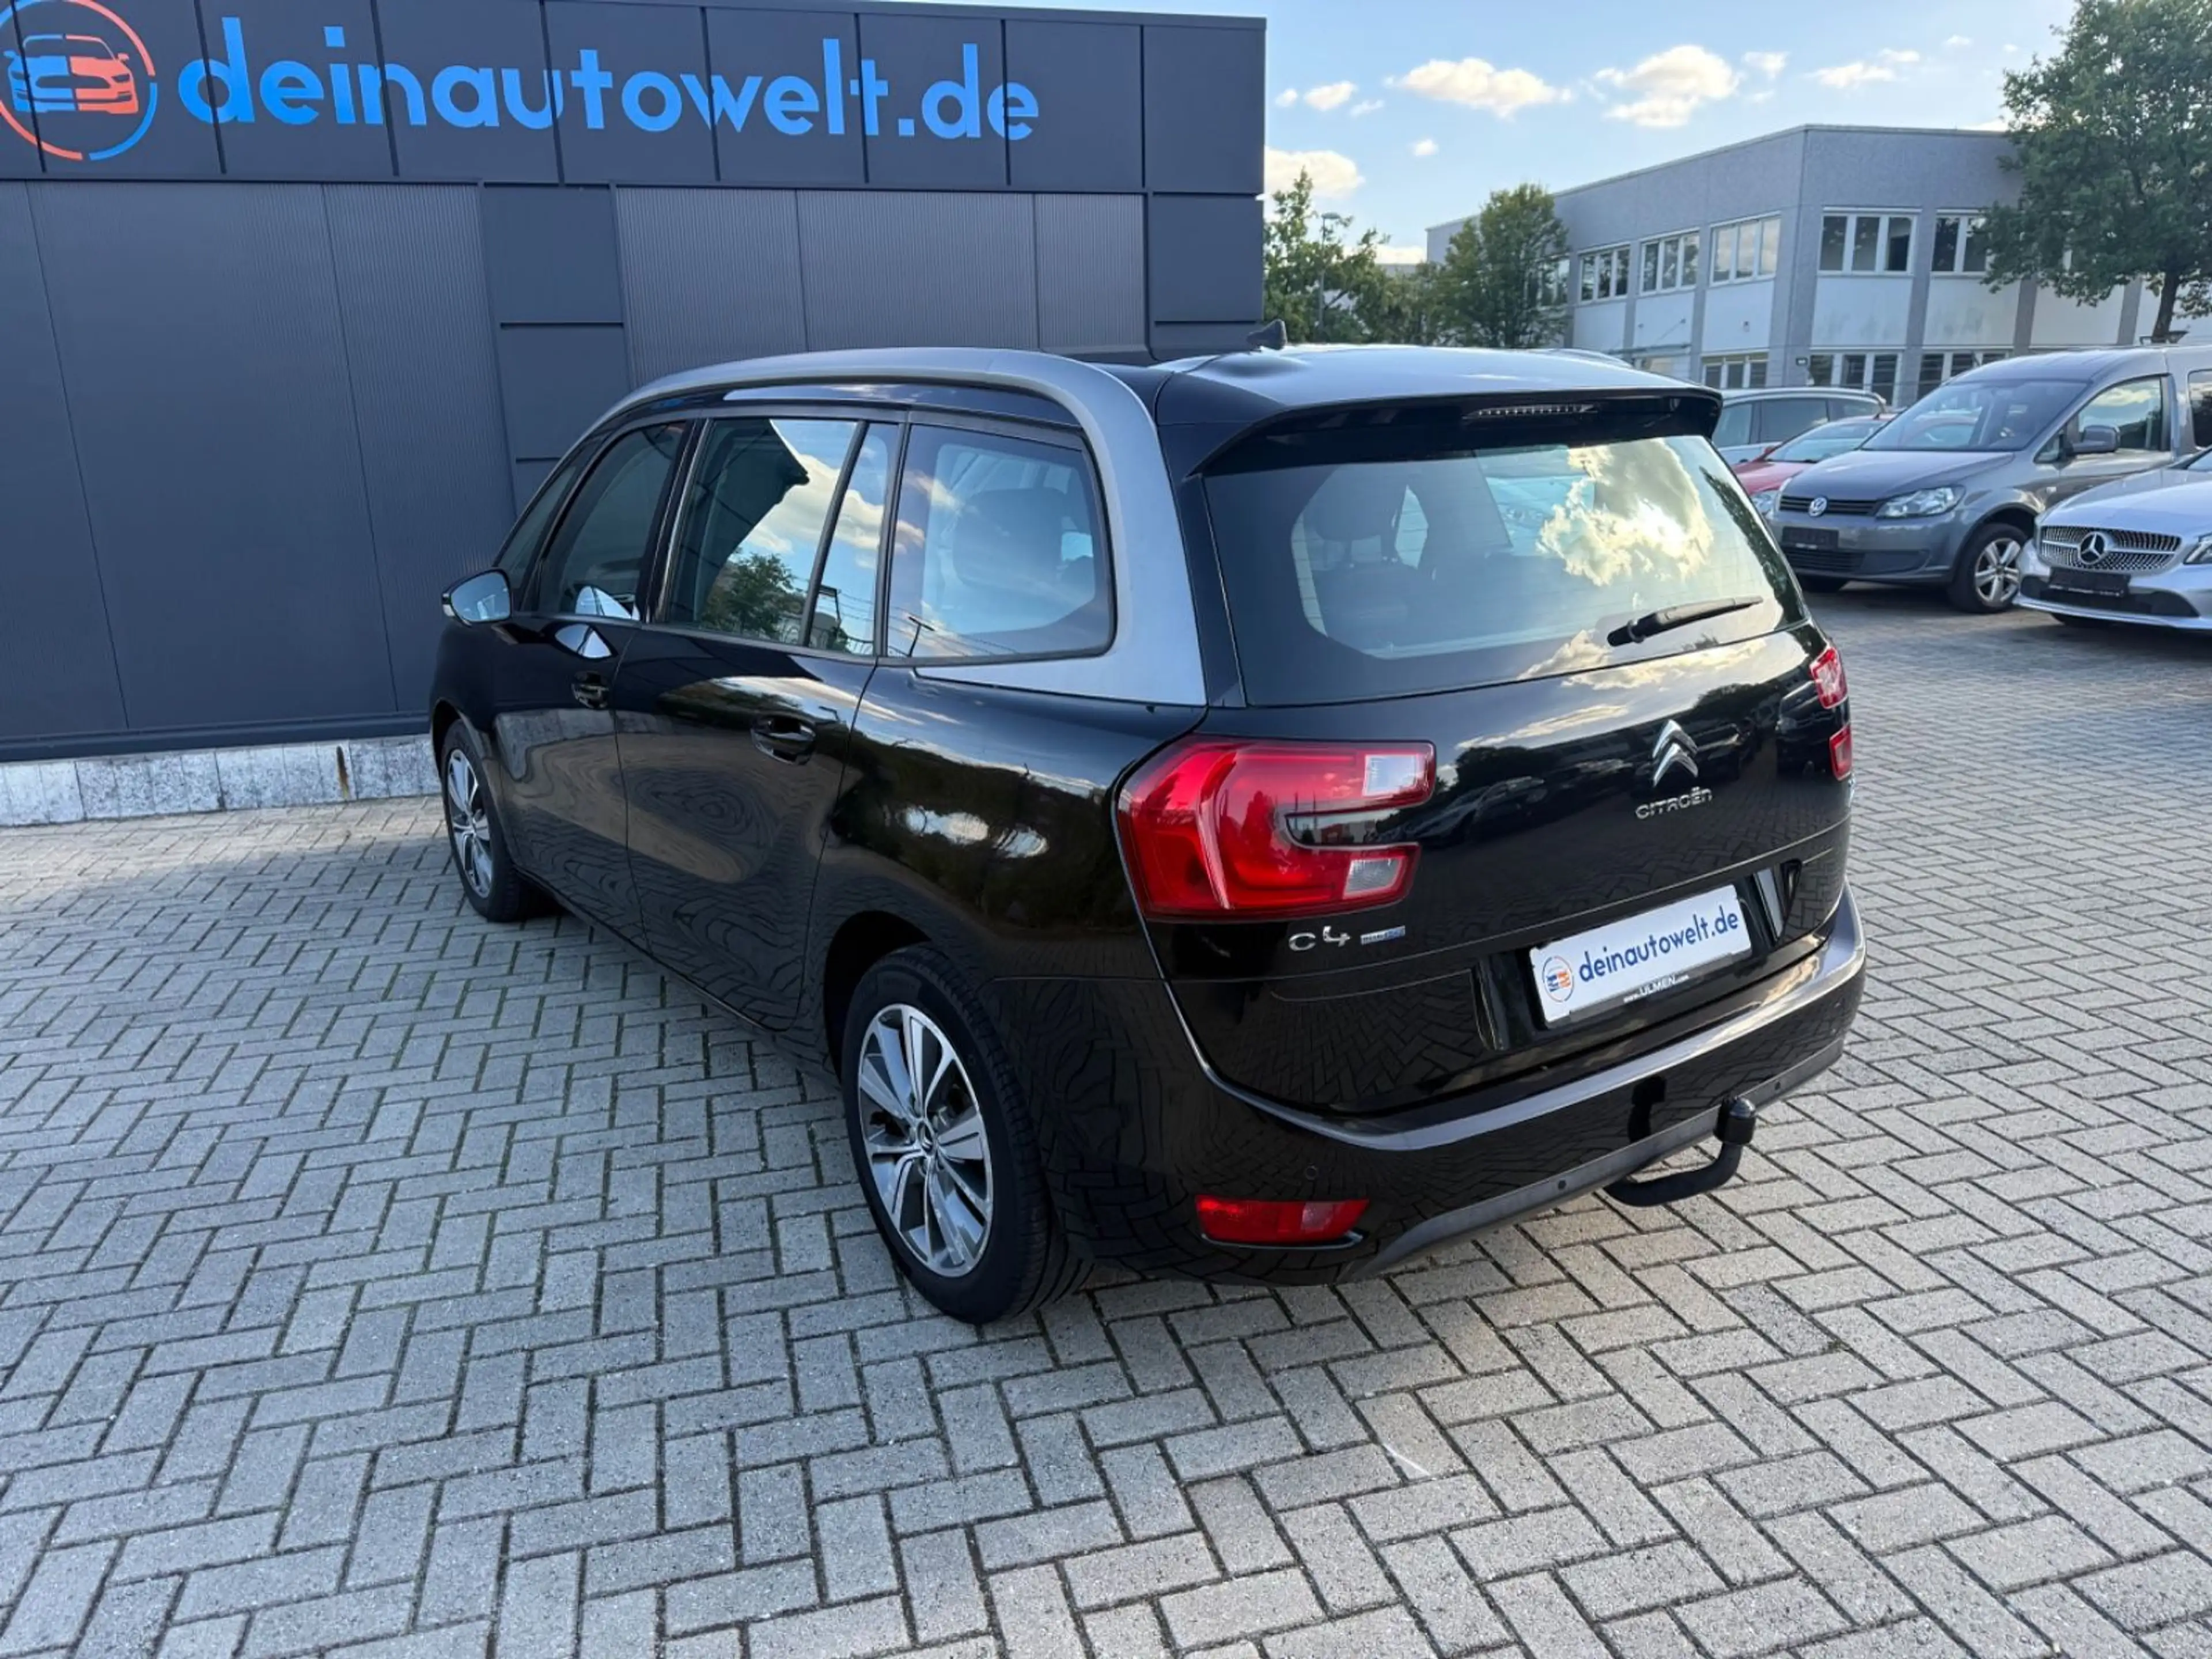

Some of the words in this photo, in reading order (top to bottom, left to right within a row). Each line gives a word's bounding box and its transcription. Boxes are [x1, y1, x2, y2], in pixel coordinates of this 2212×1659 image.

[178, 17, 1039, 141] deinautowelt.de
[1288, 925, 1351, 952] C4
[1579, 905, 1739, 982] deinautowelt.de
